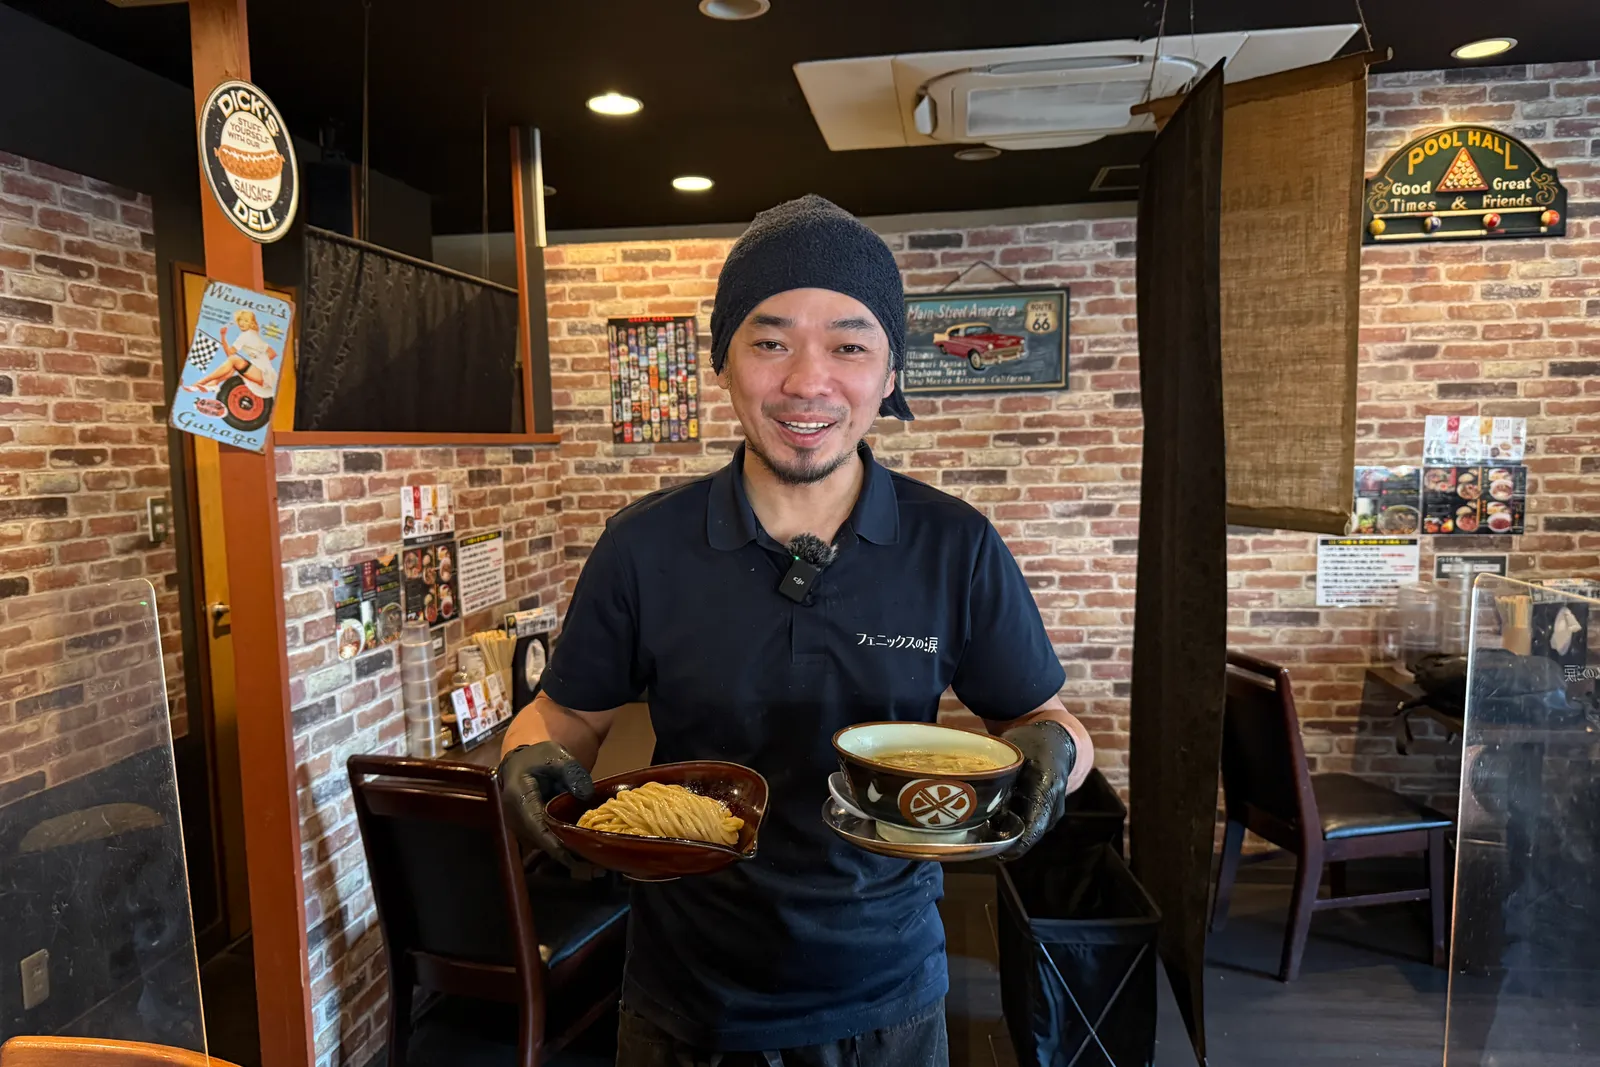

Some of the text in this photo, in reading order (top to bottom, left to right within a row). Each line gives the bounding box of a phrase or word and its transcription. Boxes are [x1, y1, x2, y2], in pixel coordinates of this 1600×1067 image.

[217, 90, 279, 137] DICK'S
[230, 122, 270, 144] YOURSELF
[237, 117, 262, 132] STUFF
[227, 130, 261, 150] WITH OUR
[1407, 130, 1519, 176] POOL HALL
[234, 178, 273, 202] SAUSAGE
[1391, 180, 1432, 197] Good
[1492, 176, 1532, 192] Great
[1390, 195, 1469, 212] Times &
[1482, 193, 1533, 208] Friends
[232, 198, 277, 231] DELI
[906, 302, 1018, 321] Main Street America
[1032, 317, 1051, 332] 66
[177, 411, 259, 446] Garage
[856, 633, 939, 654] フェニックスの涙
